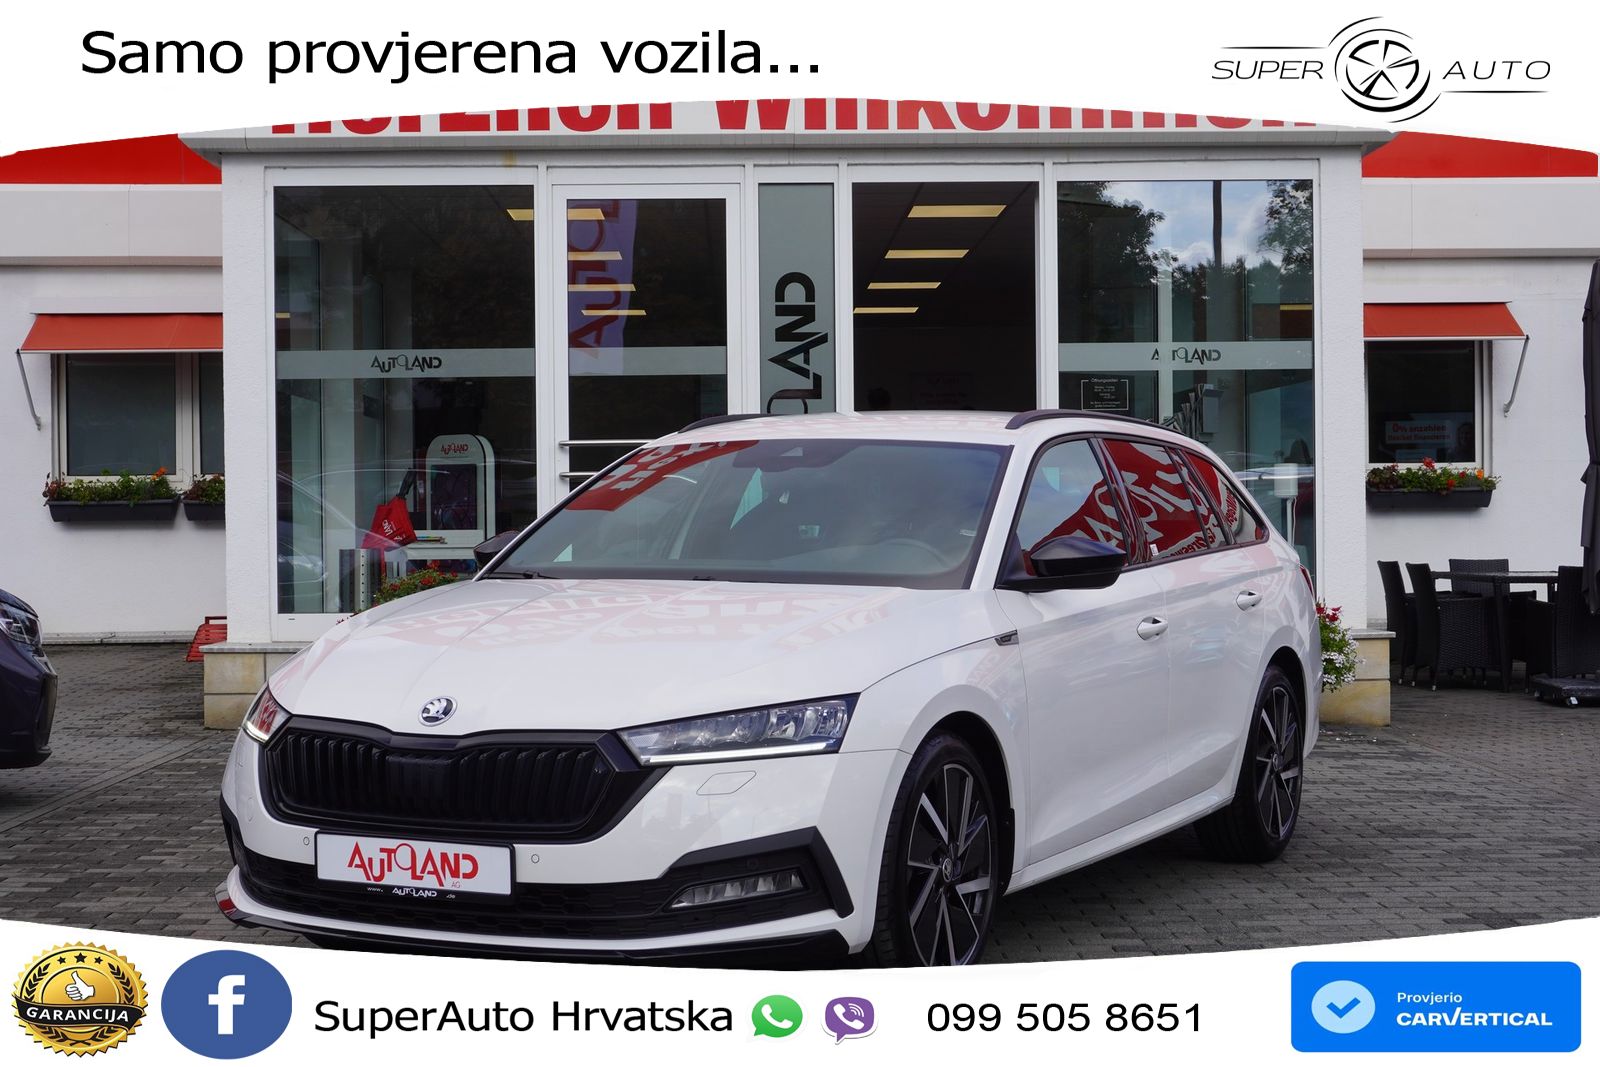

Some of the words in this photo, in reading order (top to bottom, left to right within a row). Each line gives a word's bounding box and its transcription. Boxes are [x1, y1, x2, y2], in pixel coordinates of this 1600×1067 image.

[370, 353, 443, 373] AUTOLAND
[347, 841, 479, 887] AUTOLAND
[391, 887, 438, 898] AUTOLAND
